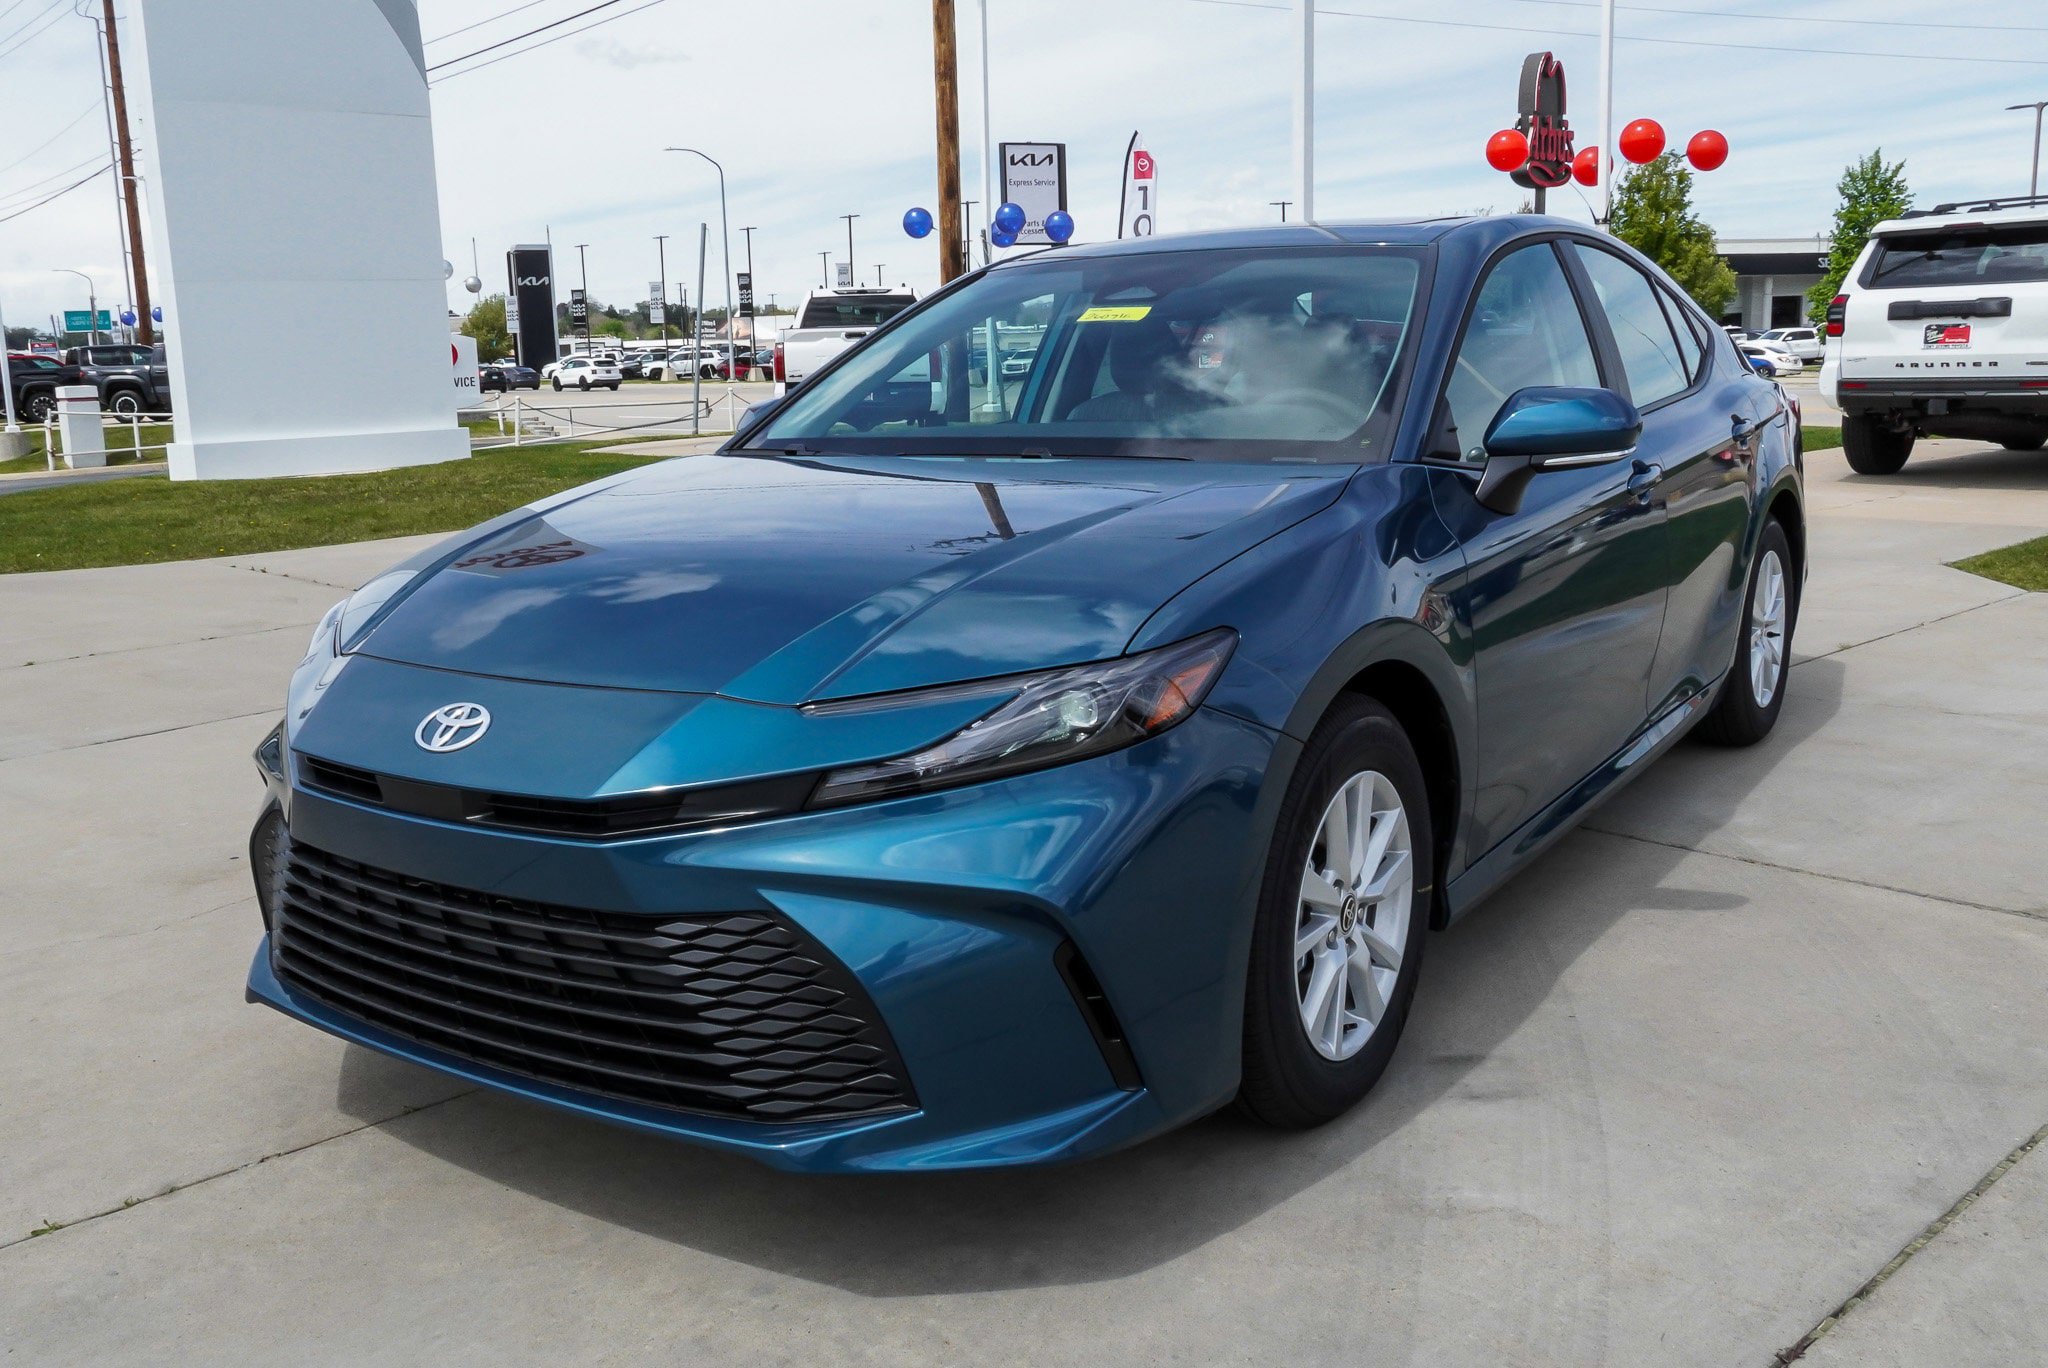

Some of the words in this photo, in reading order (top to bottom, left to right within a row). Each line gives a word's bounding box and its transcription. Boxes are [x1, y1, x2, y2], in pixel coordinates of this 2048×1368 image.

[1530, 115, 1574, 162] Arby's
[1010, 153, 1053, 166] KIA
[1009, 178, 1033, 187] Express
[1034, 178, 1056, 186] Service
[1818, 257, 1831, 268] SE
[517, 276, 550, 286] KIA
[453, 376, 476, 387] VICE
